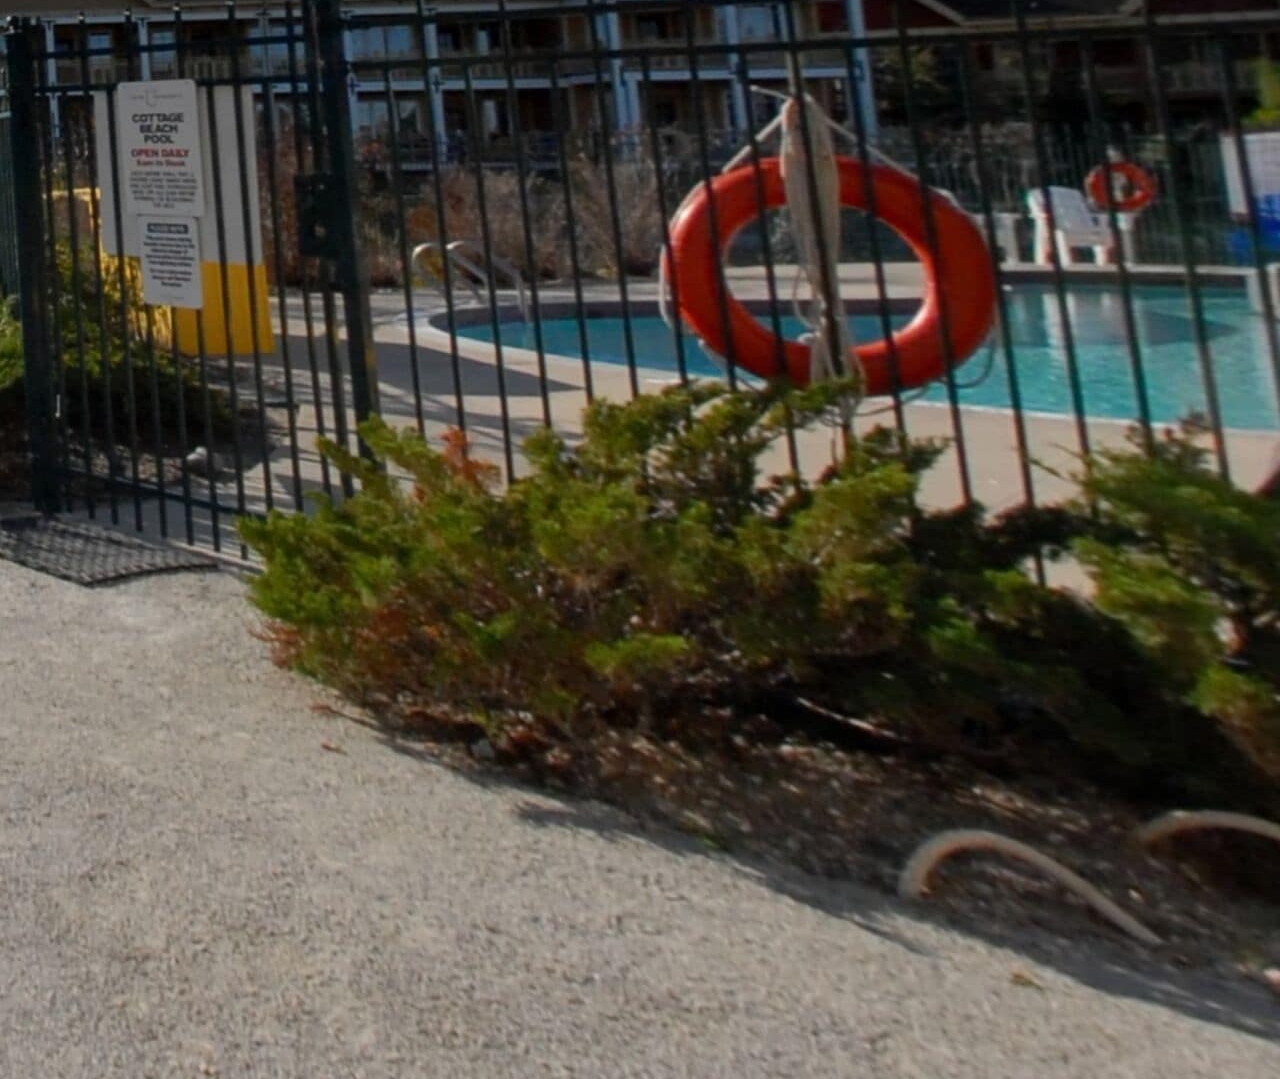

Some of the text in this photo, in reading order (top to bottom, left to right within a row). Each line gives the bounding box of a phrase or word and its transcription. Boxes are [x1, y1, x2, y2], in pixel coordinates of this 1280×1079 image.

[131, 112, 185, 123] COTTAGE
[139, 124, 179, 134] BEACH
[144, 134, 175, 144] POOL
[131, 148, 189, 158] OPEN DAILY
